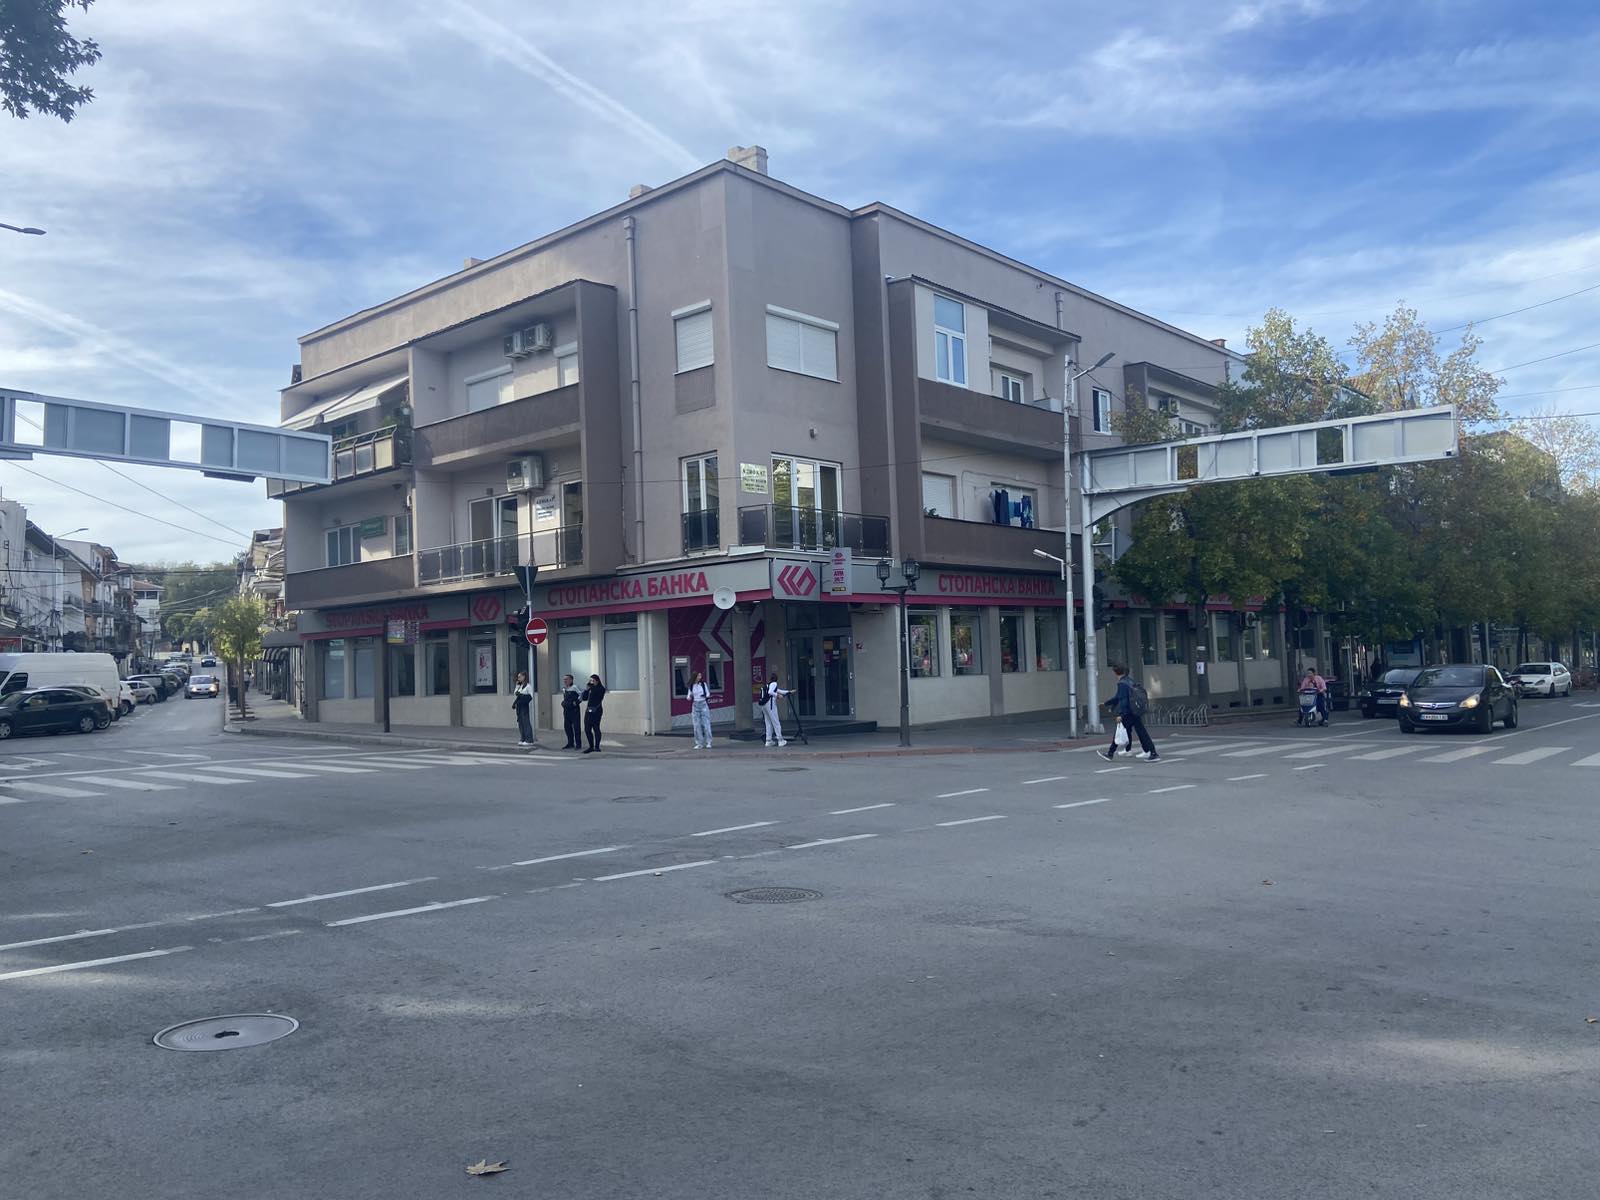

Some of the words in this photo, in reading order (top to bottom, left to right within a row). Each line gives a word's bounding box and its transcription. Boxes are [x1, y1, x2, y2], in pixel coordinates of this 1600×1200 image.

[547, 579, 643, 607] СТОПАНСКА
[647, 571, 709, 597] БАНКА
[938, 574, 1015, 594] СТОПАНСКА
[1017, 577, 1056, 595] БАНКА
